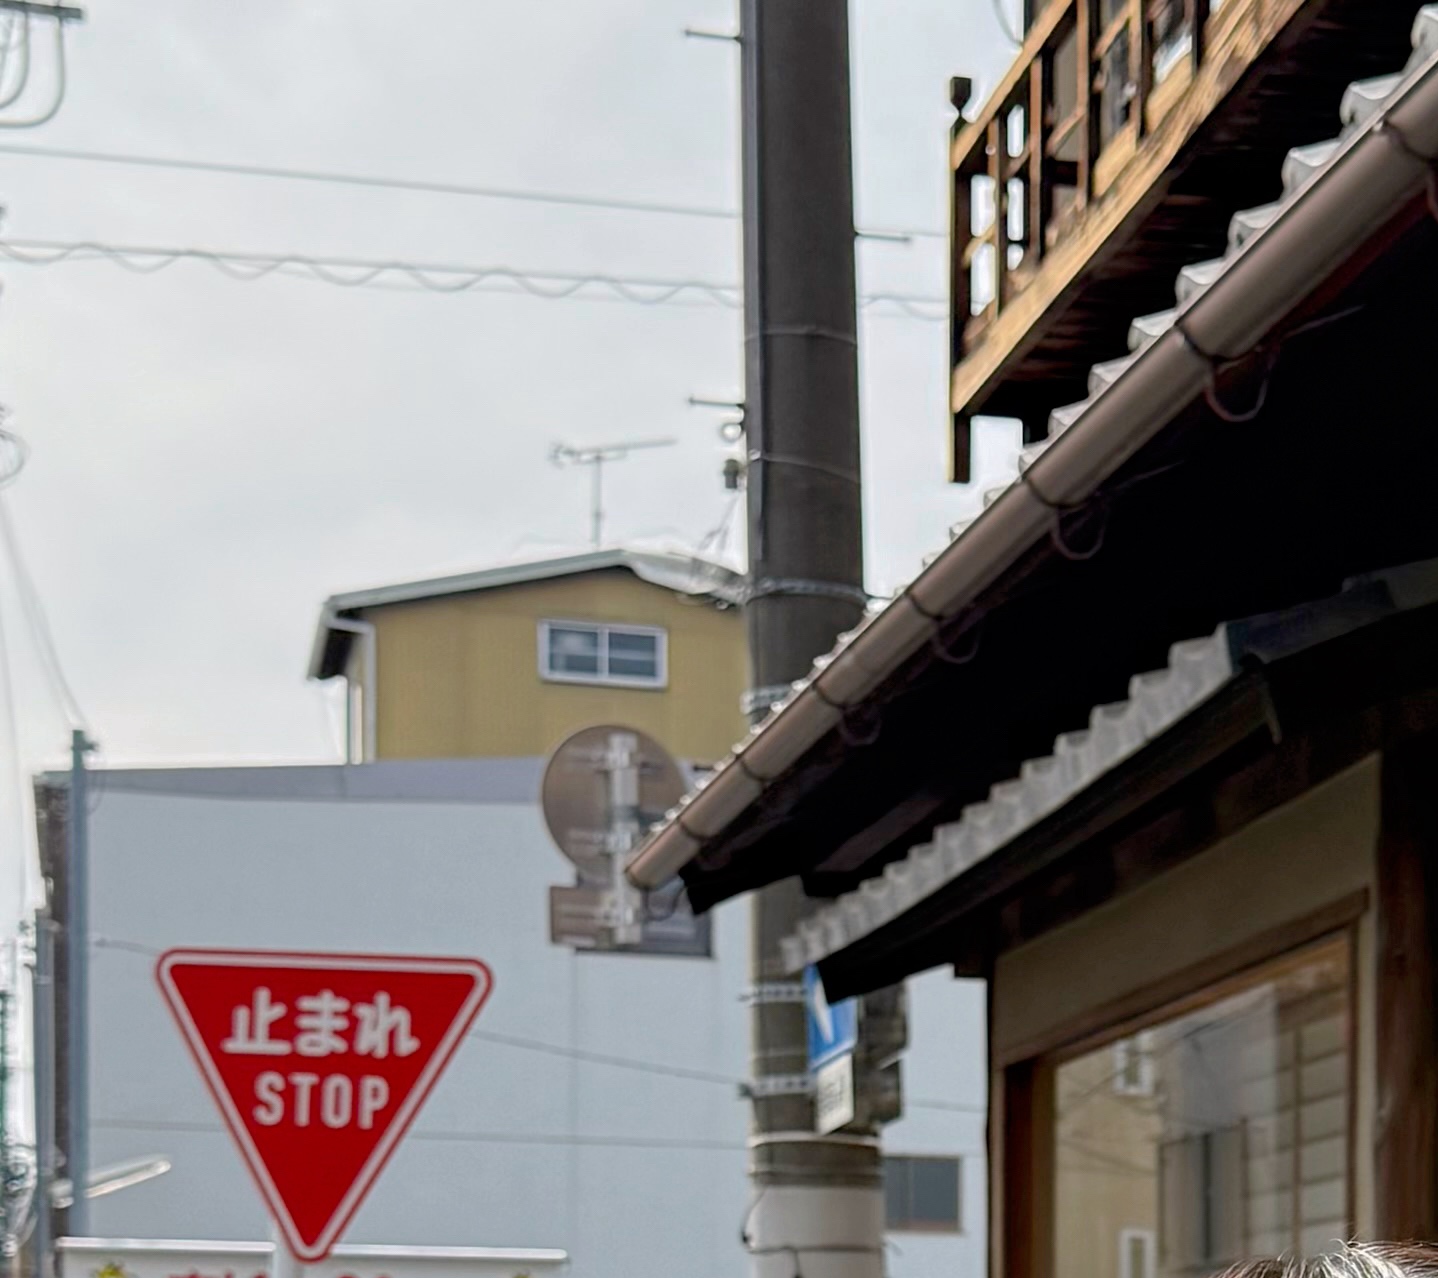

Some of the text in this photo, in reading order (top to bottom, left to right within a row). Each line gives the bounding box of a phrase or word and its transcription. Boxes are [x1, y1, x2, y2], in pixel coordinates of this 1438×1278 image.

[220, 986, 421, 1058] 止まれ
[252, 1070, 389, 1130] STOP
